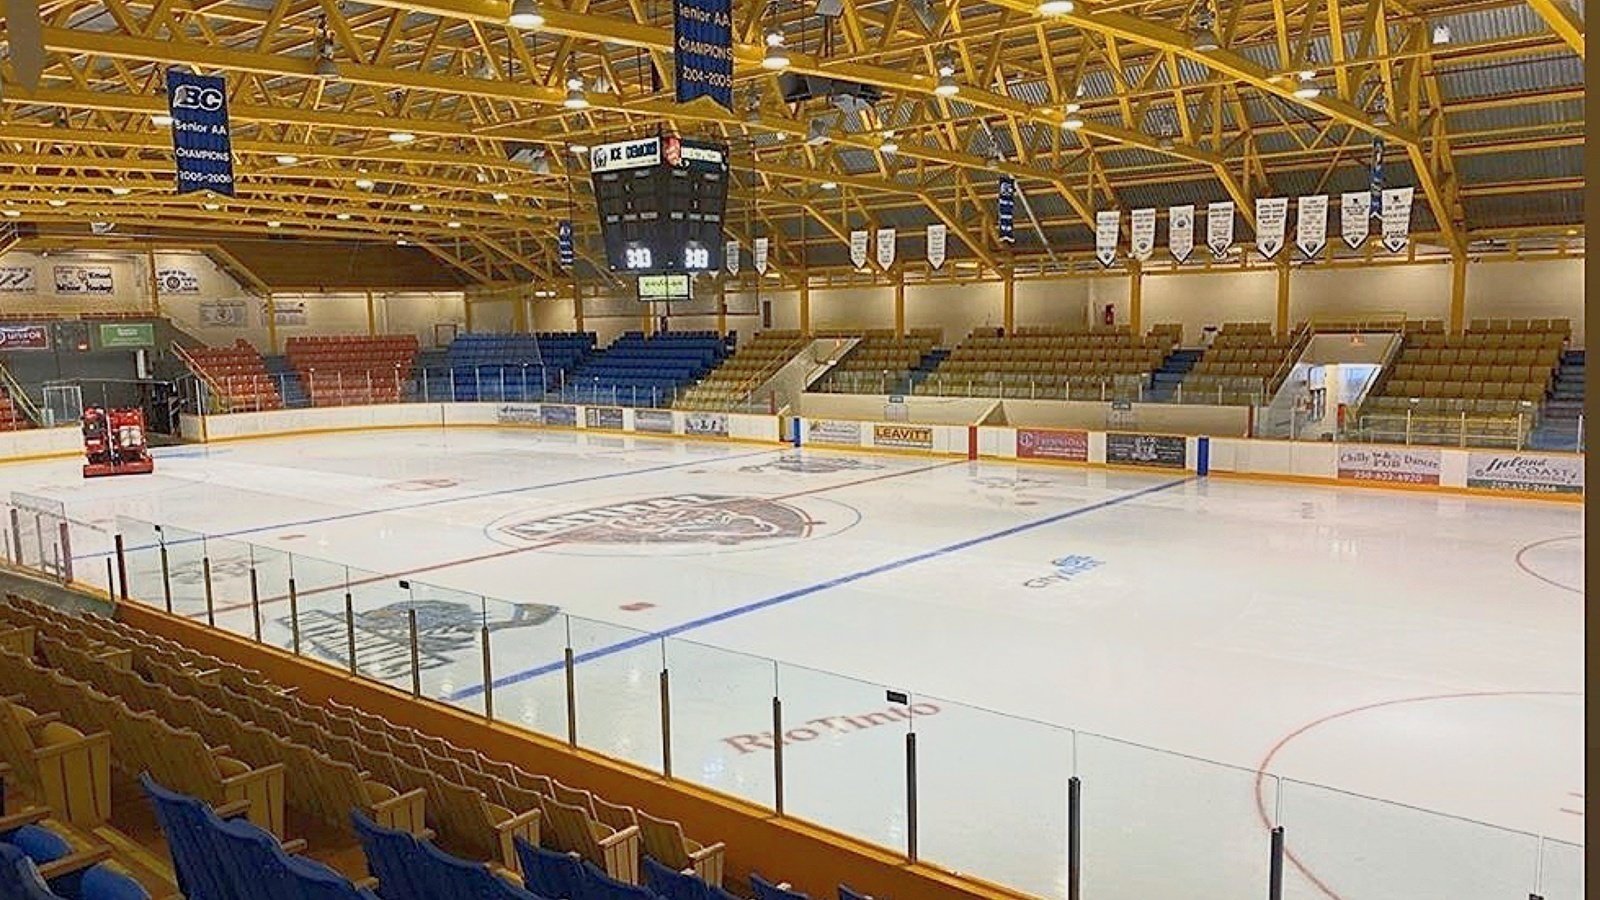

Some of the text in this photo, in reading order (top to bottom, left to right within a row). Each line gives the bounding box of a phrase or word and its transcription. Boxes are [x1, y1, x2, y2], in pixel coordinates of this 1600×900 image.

[714, 12, 731, 27] AA
[173, 85, 223, 111] BC
[175, 120, 228, 136] Senior AA
[176, 147, 230, 162] CHAMPIONS
[610, 147, 621, 161] ICE
[876, 428, 930, 441] LEAVITT
